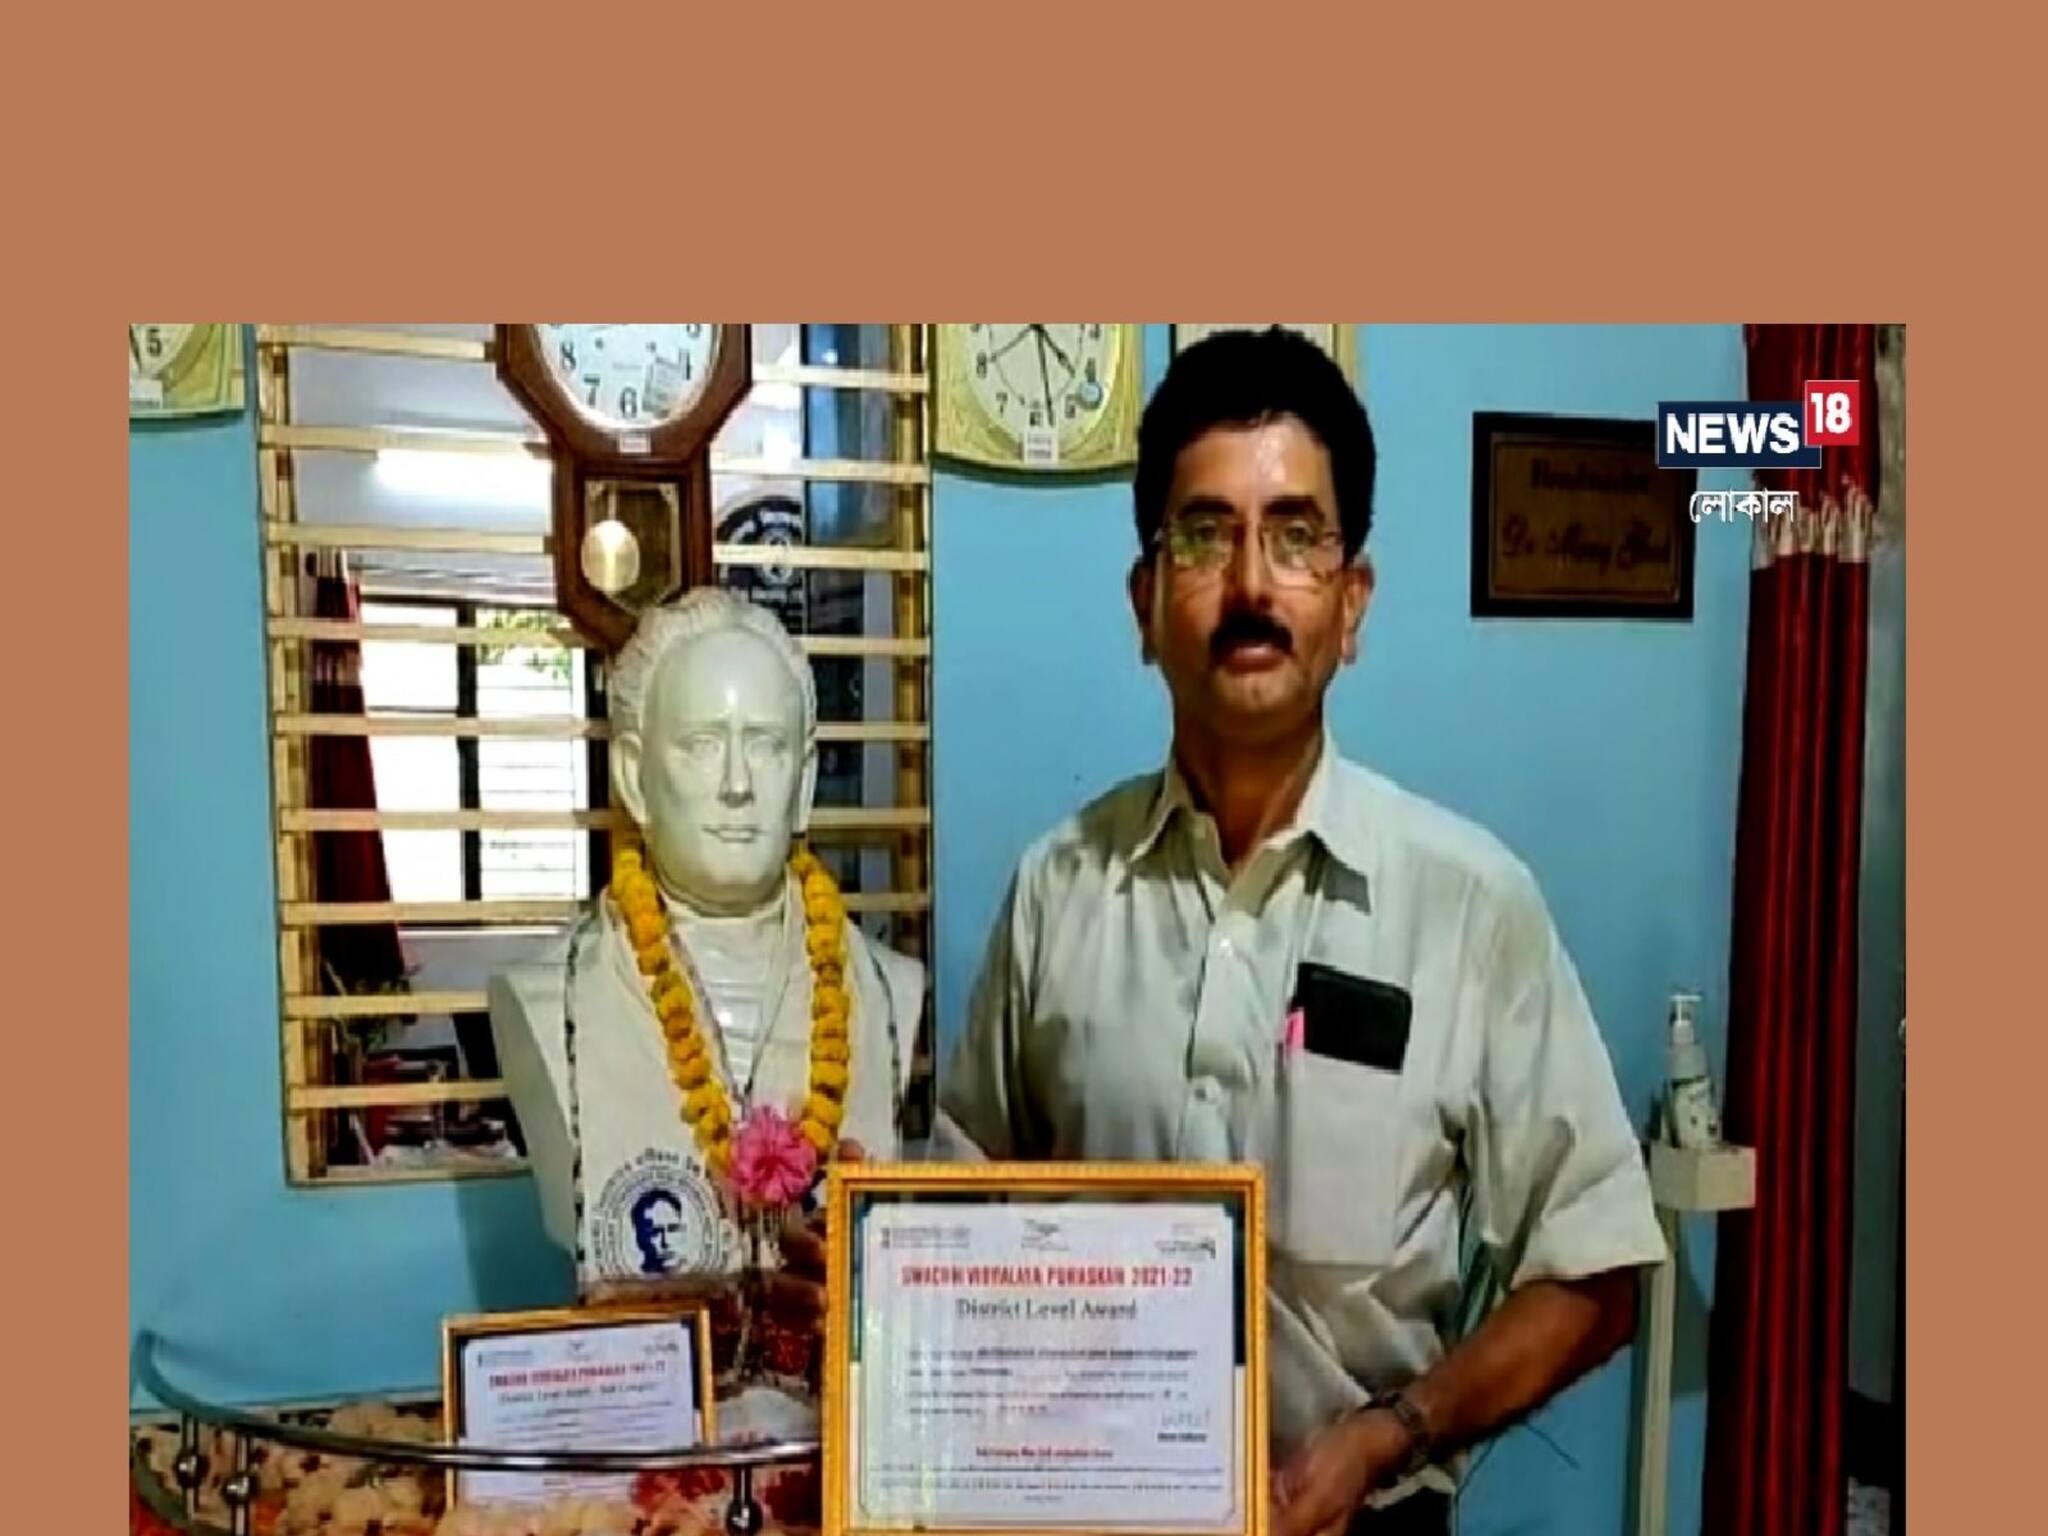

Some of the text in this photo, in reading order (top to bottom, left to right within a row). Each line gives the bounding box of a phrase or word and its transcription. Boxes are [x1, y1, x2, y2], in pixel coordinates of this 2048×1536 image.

[147, 328, 162, 357] 5
[560, 341, 577, 371] 8
[583, 374, 601, 407] 7
[619, 386, 638, 419] 6
[956, 1299, 1137, 1319] District Level Award
